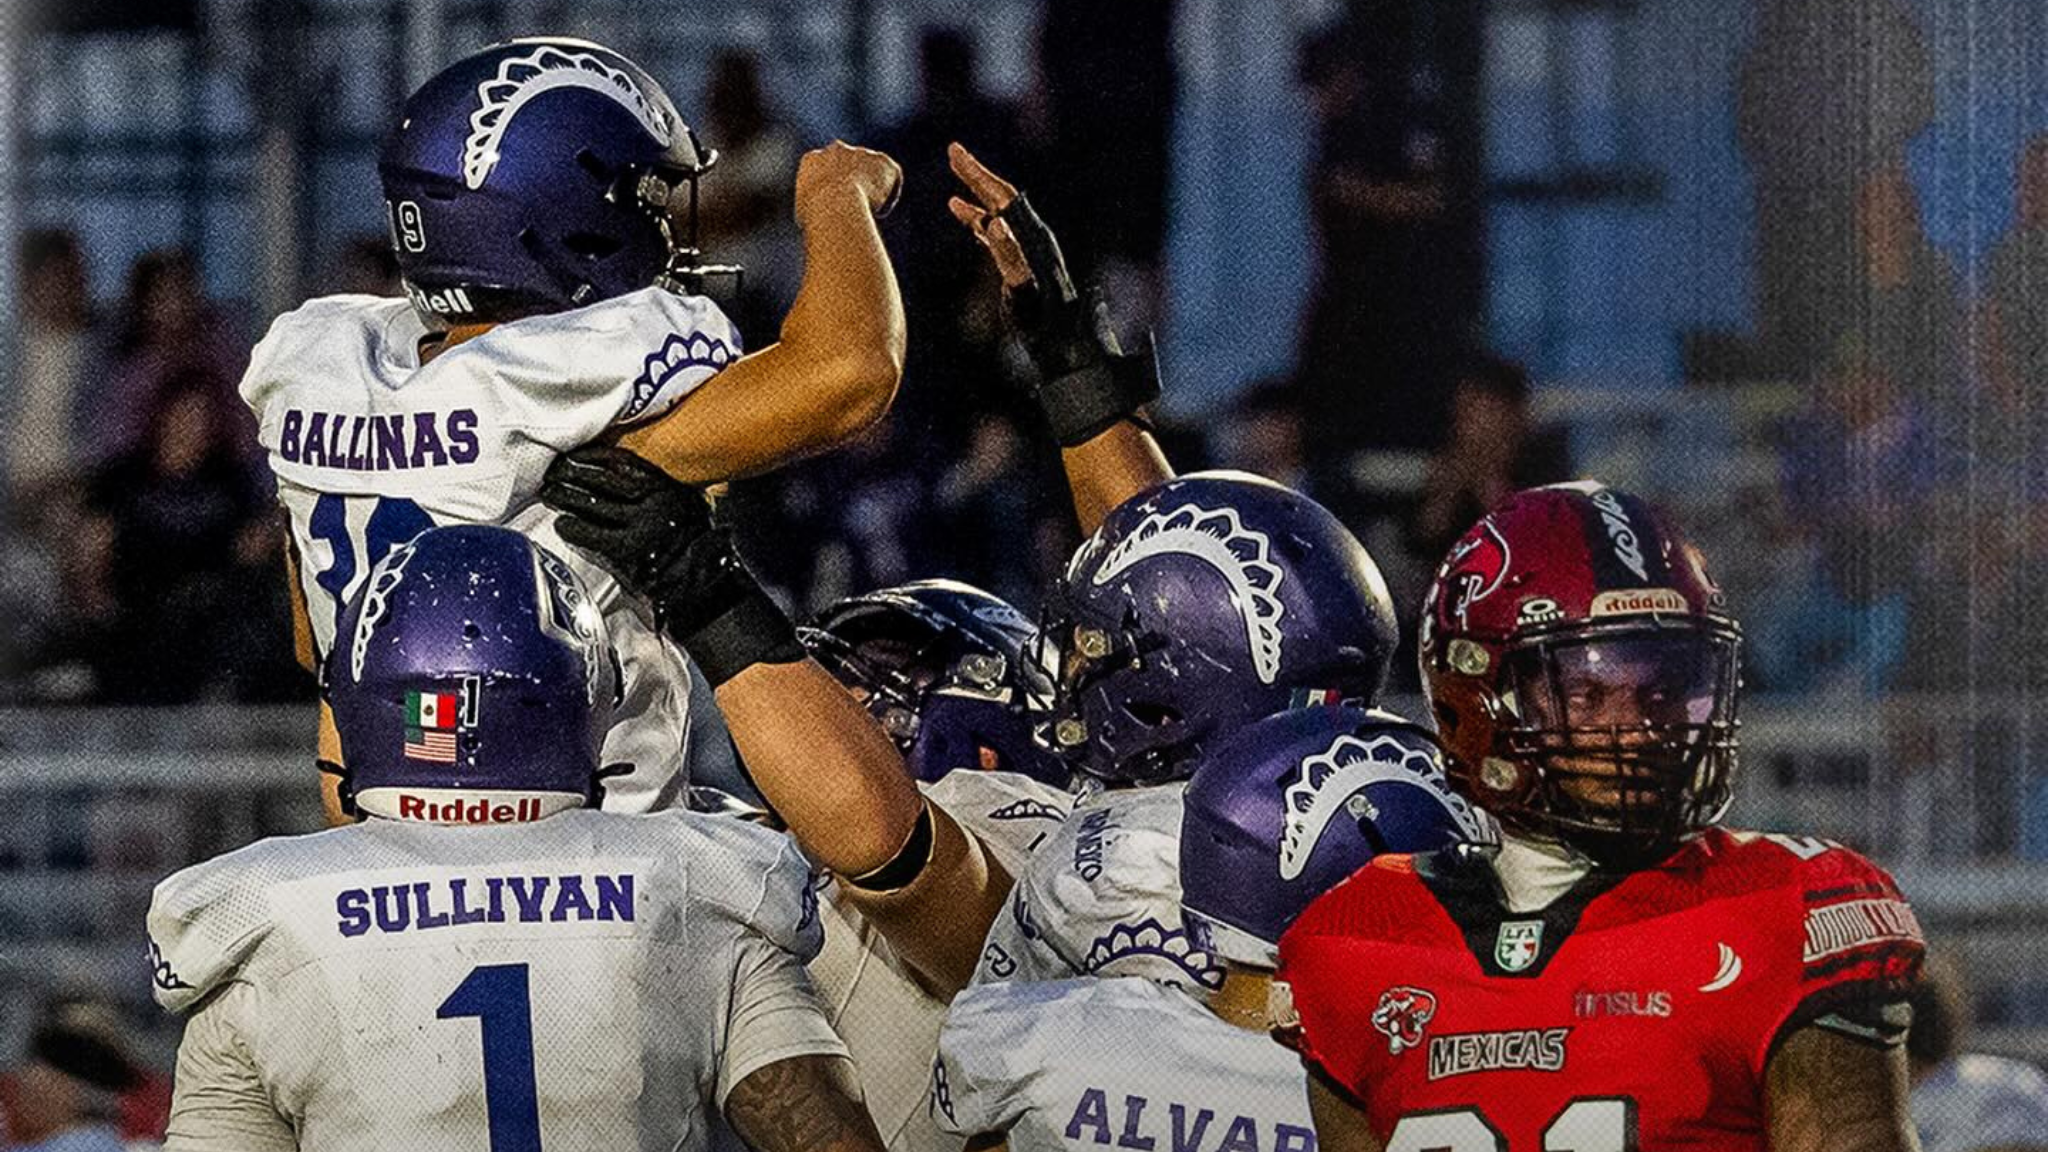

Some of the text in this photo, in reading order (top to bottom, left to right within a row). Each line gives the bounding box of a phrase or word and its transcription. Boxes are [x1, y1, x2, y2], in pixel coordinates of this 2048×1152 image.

[280, 409, 480, 471] BALLINAS
[464, 675, 481, 728] 1
[399, 795, 541, 824] Riddell
[336, 875, 635, 938] SULLIVAN
[436, 962, 542, 1152] 1
[1428, 1028, 1571, 1081] MEXICAS
